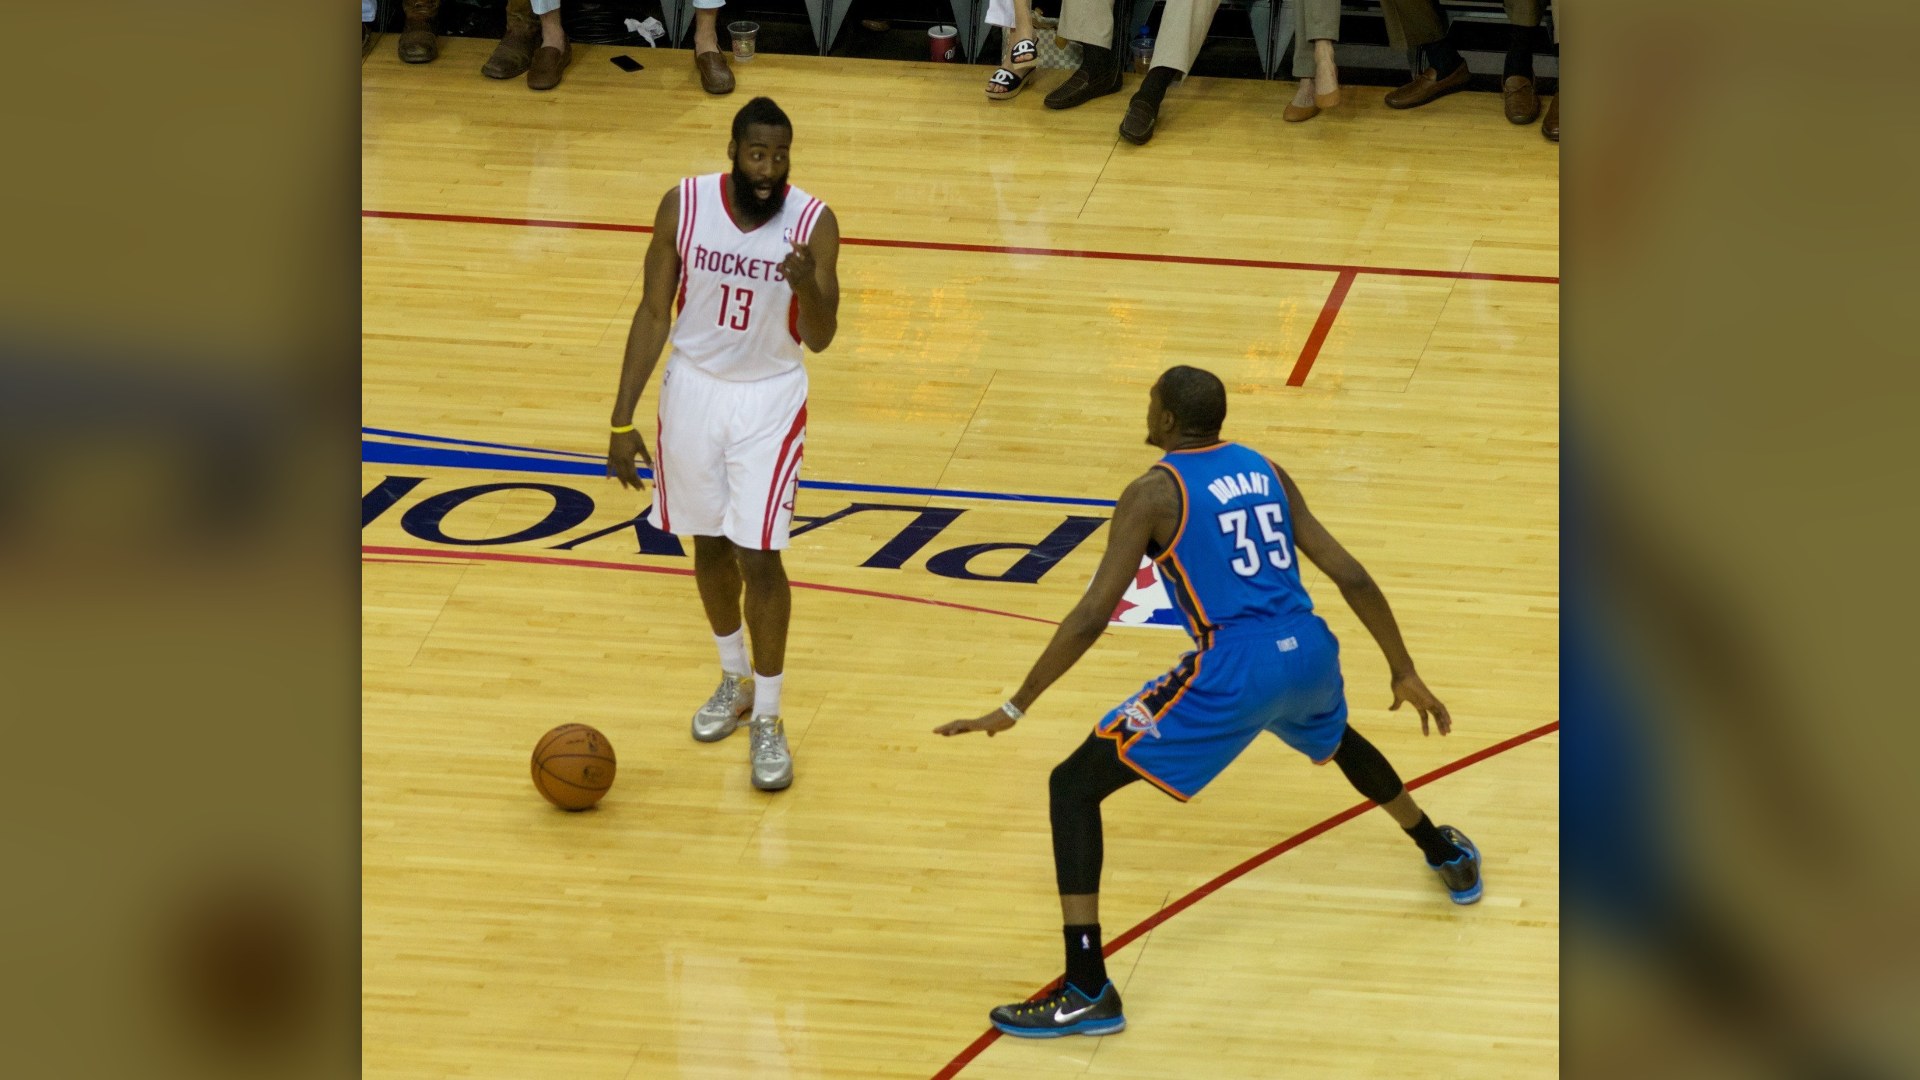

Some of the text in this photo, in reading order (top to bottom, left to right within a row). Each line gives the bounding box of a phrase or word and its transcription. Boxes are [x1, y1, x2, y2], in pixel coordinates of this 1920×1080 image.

[694, 244, 785, 282] ROCKETS
[717, 283, 754, 331] 13
[1207, 471, 1269, 505] DURANT
[1217, 503, 1292, 577] 35
